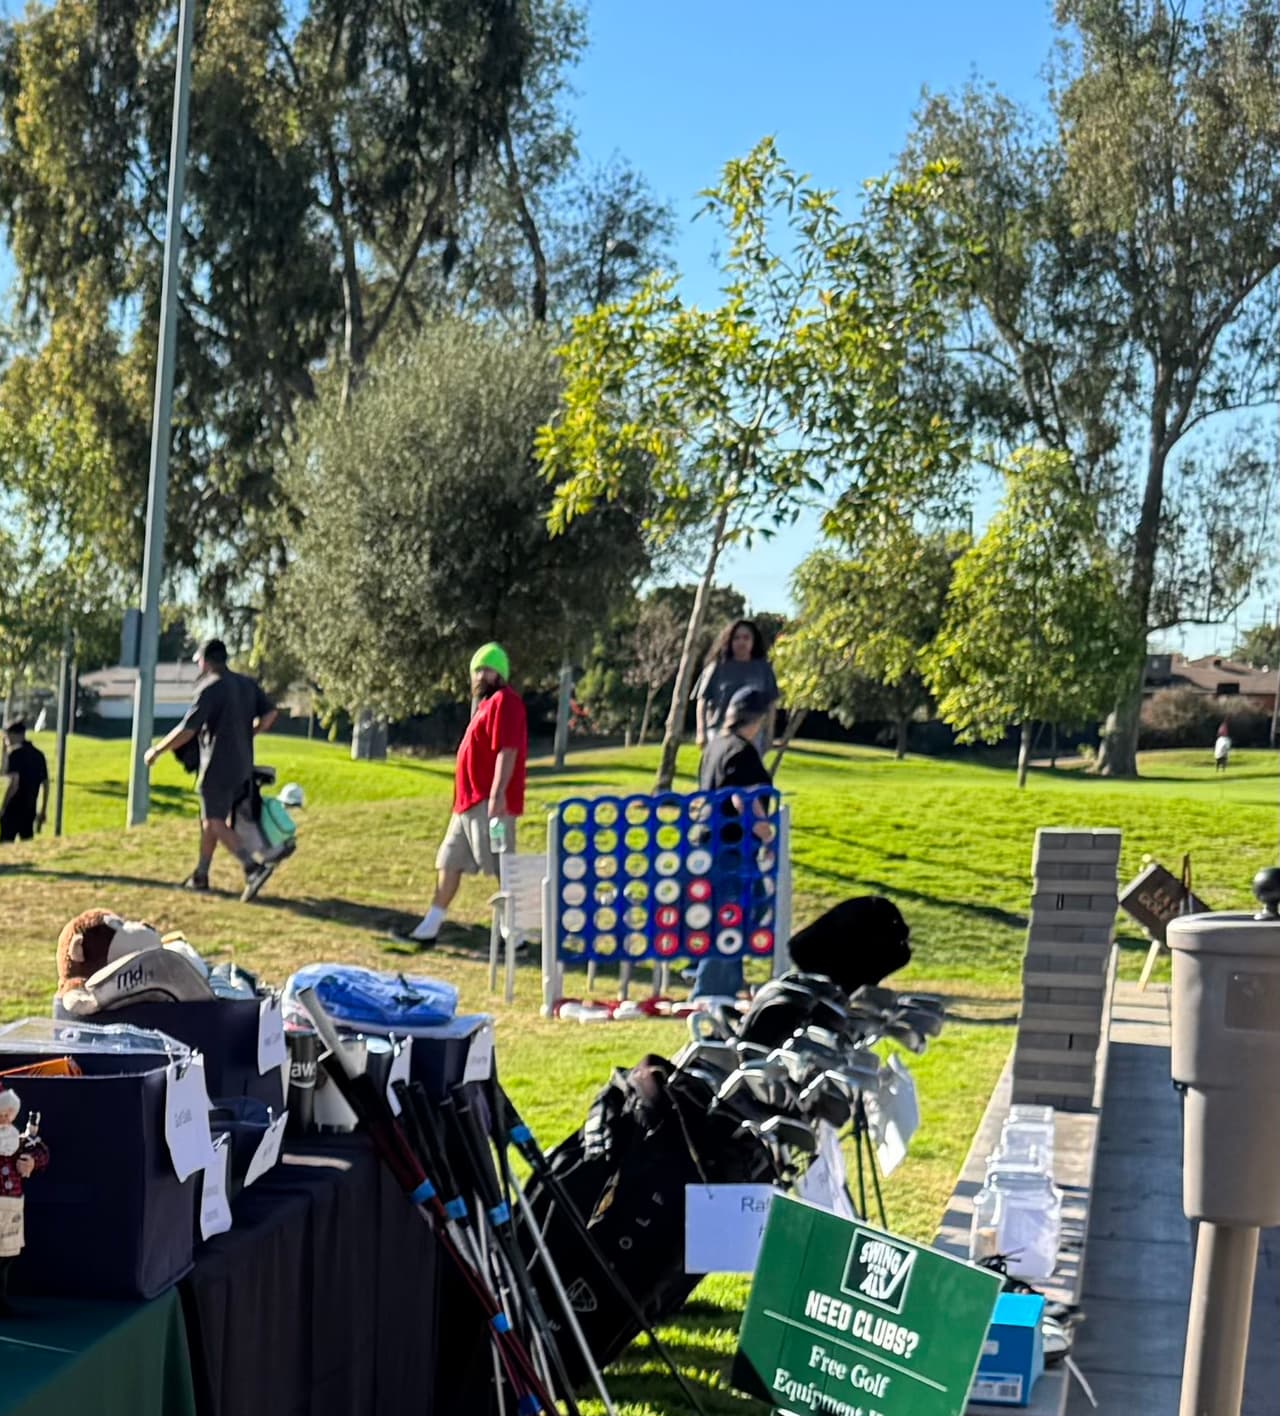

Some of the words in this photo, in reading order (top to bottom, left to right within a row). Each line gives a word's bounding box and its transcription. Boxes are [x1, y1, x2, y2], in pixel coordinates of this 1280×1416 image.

[859, 1240, 903, 1276] SWING
[867, 1263, 888, 1278] FOR
[804, 1289, 853, 1332] NEED
[852, 1309, 920, 1359] CLUBS?
[808, 1344, 847, 1380] Free
[850, 1363, 891, 1399] Golf
